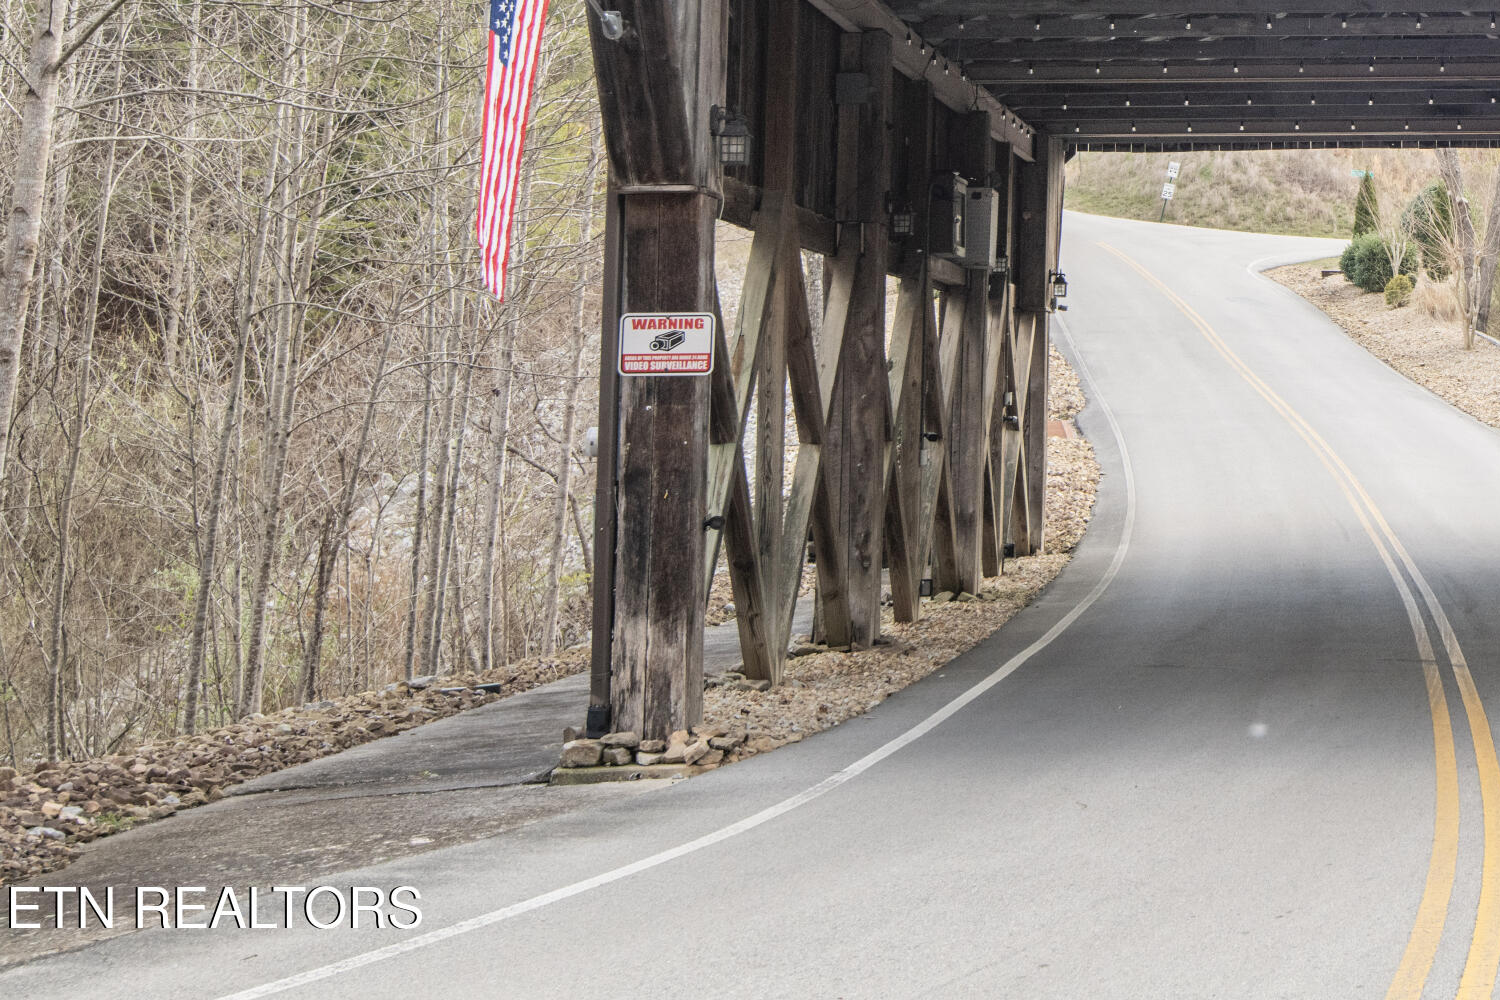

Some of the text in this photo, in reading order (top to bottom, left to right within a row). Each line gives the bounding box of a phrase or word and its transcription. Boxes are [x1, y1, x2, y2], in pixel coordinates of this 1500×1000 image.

[632, 318, 704, 330] WARNING
[624, 360, 708, 370] VIDEO SURVEILLANCE
